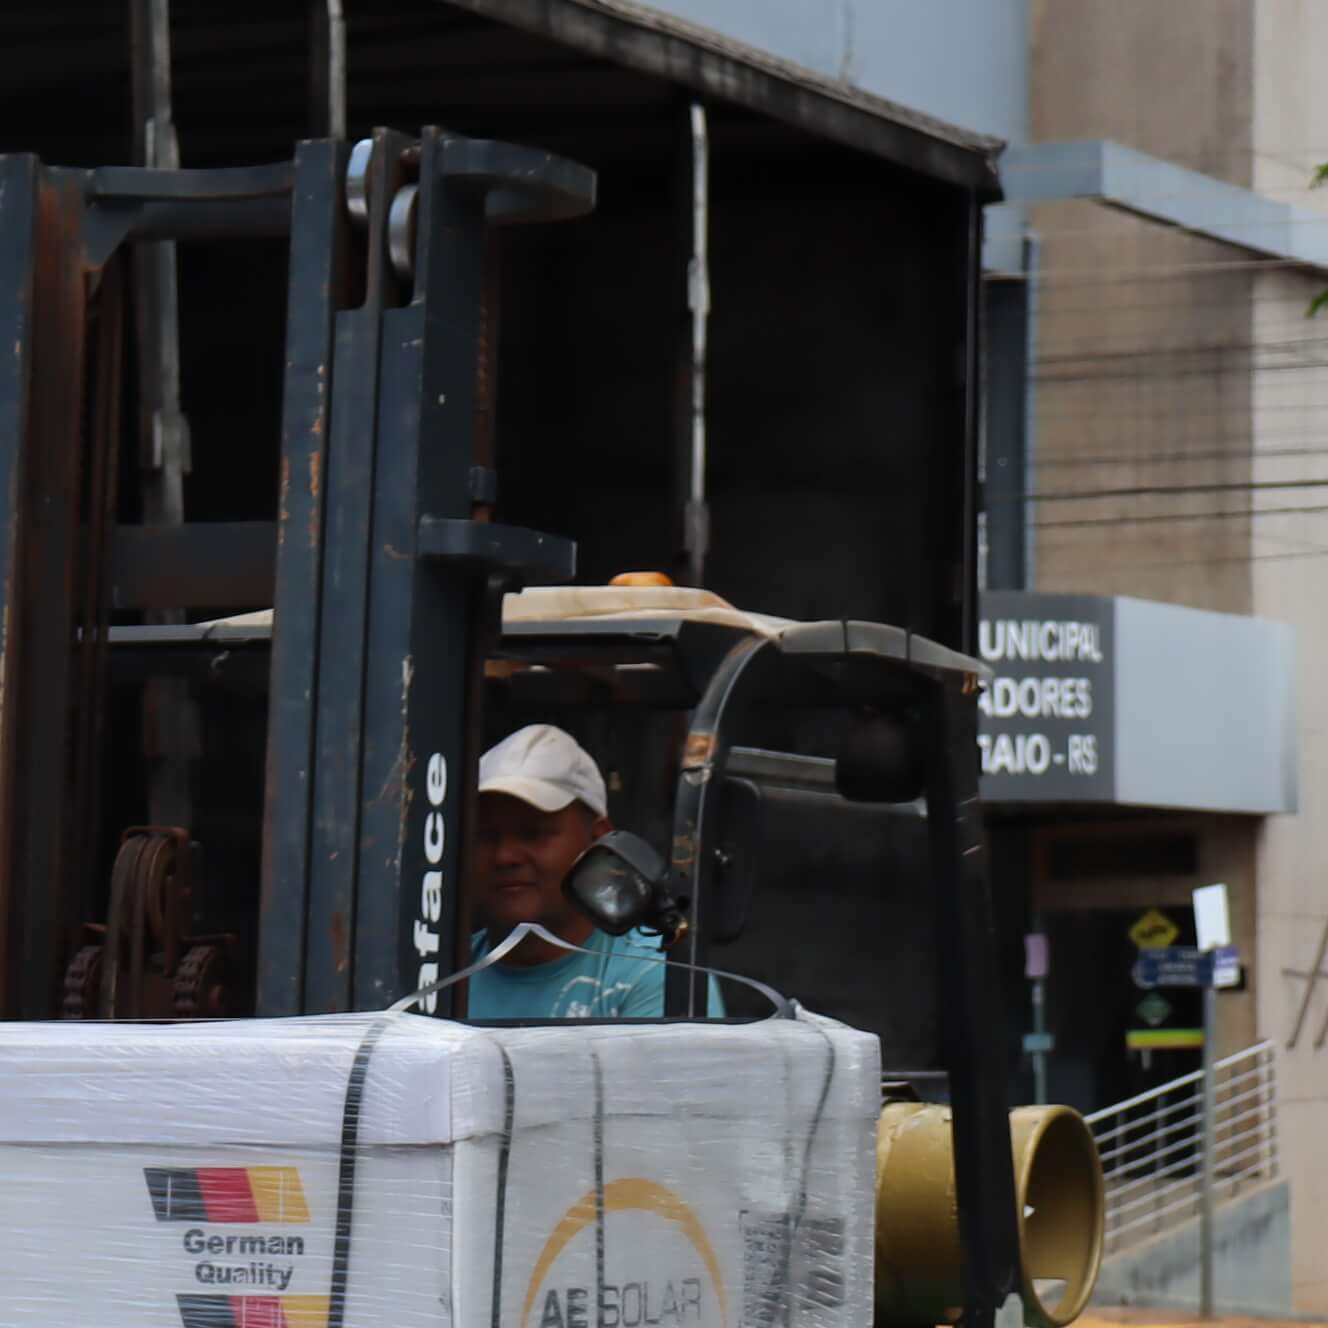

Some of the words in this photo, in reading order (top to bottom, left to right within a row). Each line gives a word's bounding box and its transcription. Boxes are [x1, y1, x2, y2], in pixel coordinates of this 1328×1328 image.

[978, 620, 1103, 663] UNICIPAL
[1068, 734, 1097, 775] RS
[182, 1228, 305, 1256] German
[195, 1261, 294, 1290] Quality
